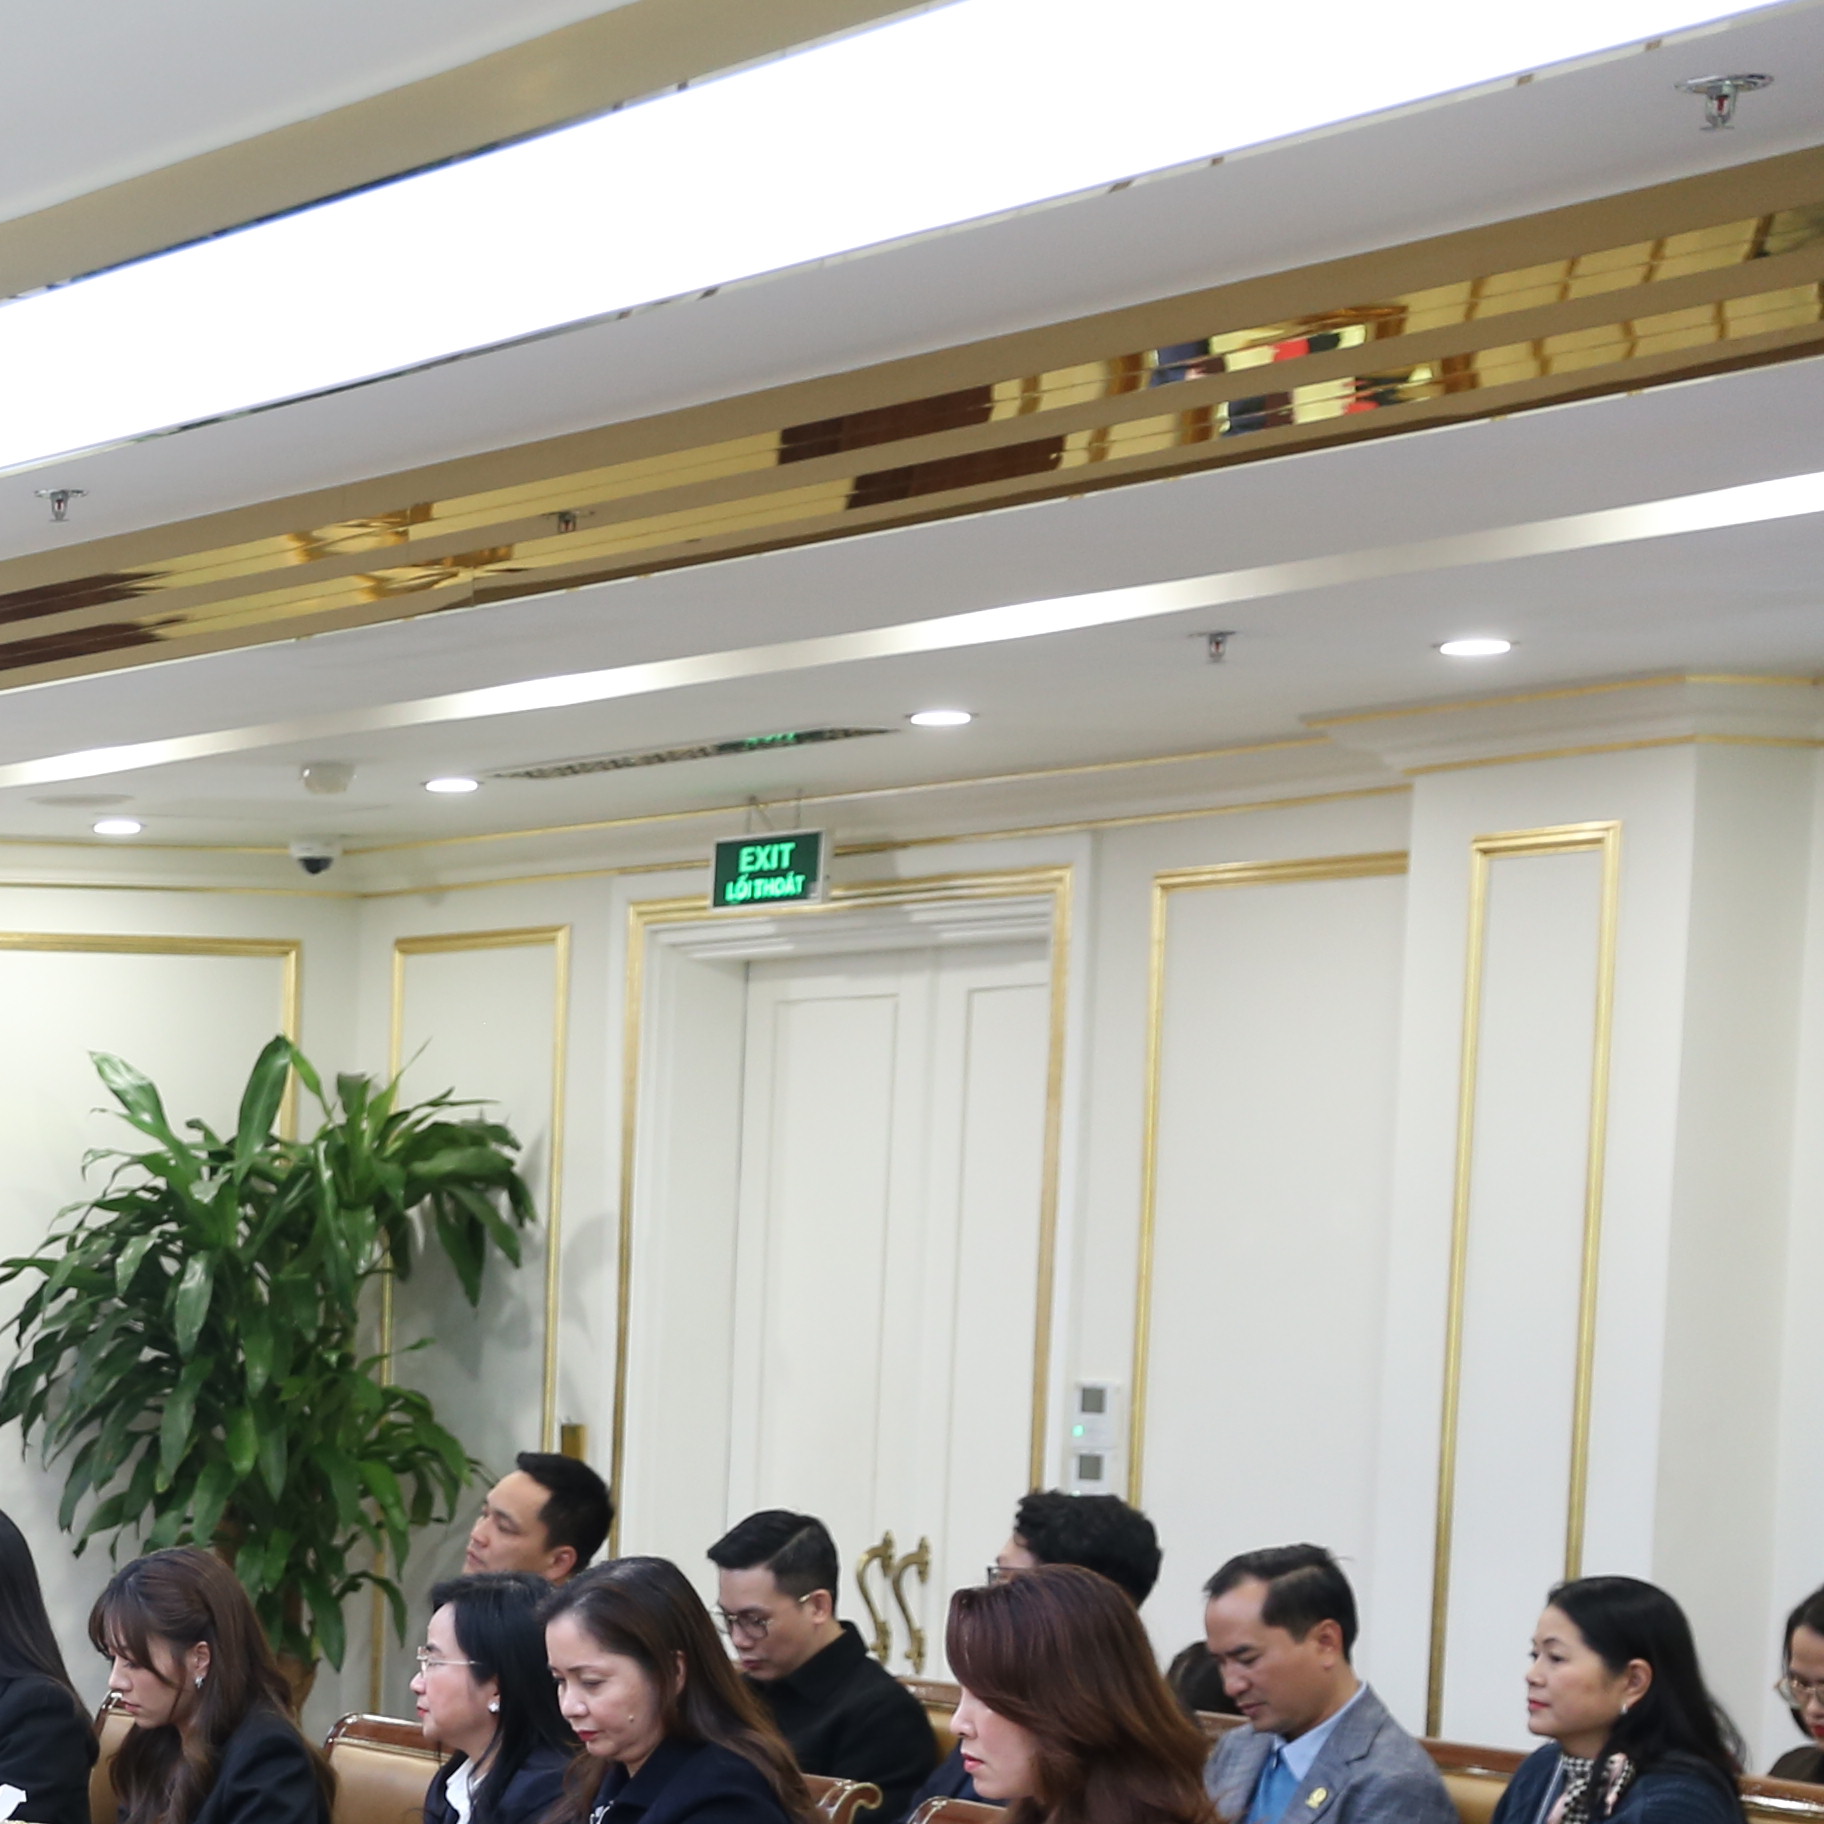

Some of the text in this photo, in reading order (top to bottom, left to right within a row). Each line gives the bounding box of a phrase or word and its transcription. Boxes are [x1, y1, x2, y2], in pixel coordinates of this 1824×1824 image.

[739, 842, 796, 873] EXIT
[725, 871, 806, 903] LỐI THOÁT
